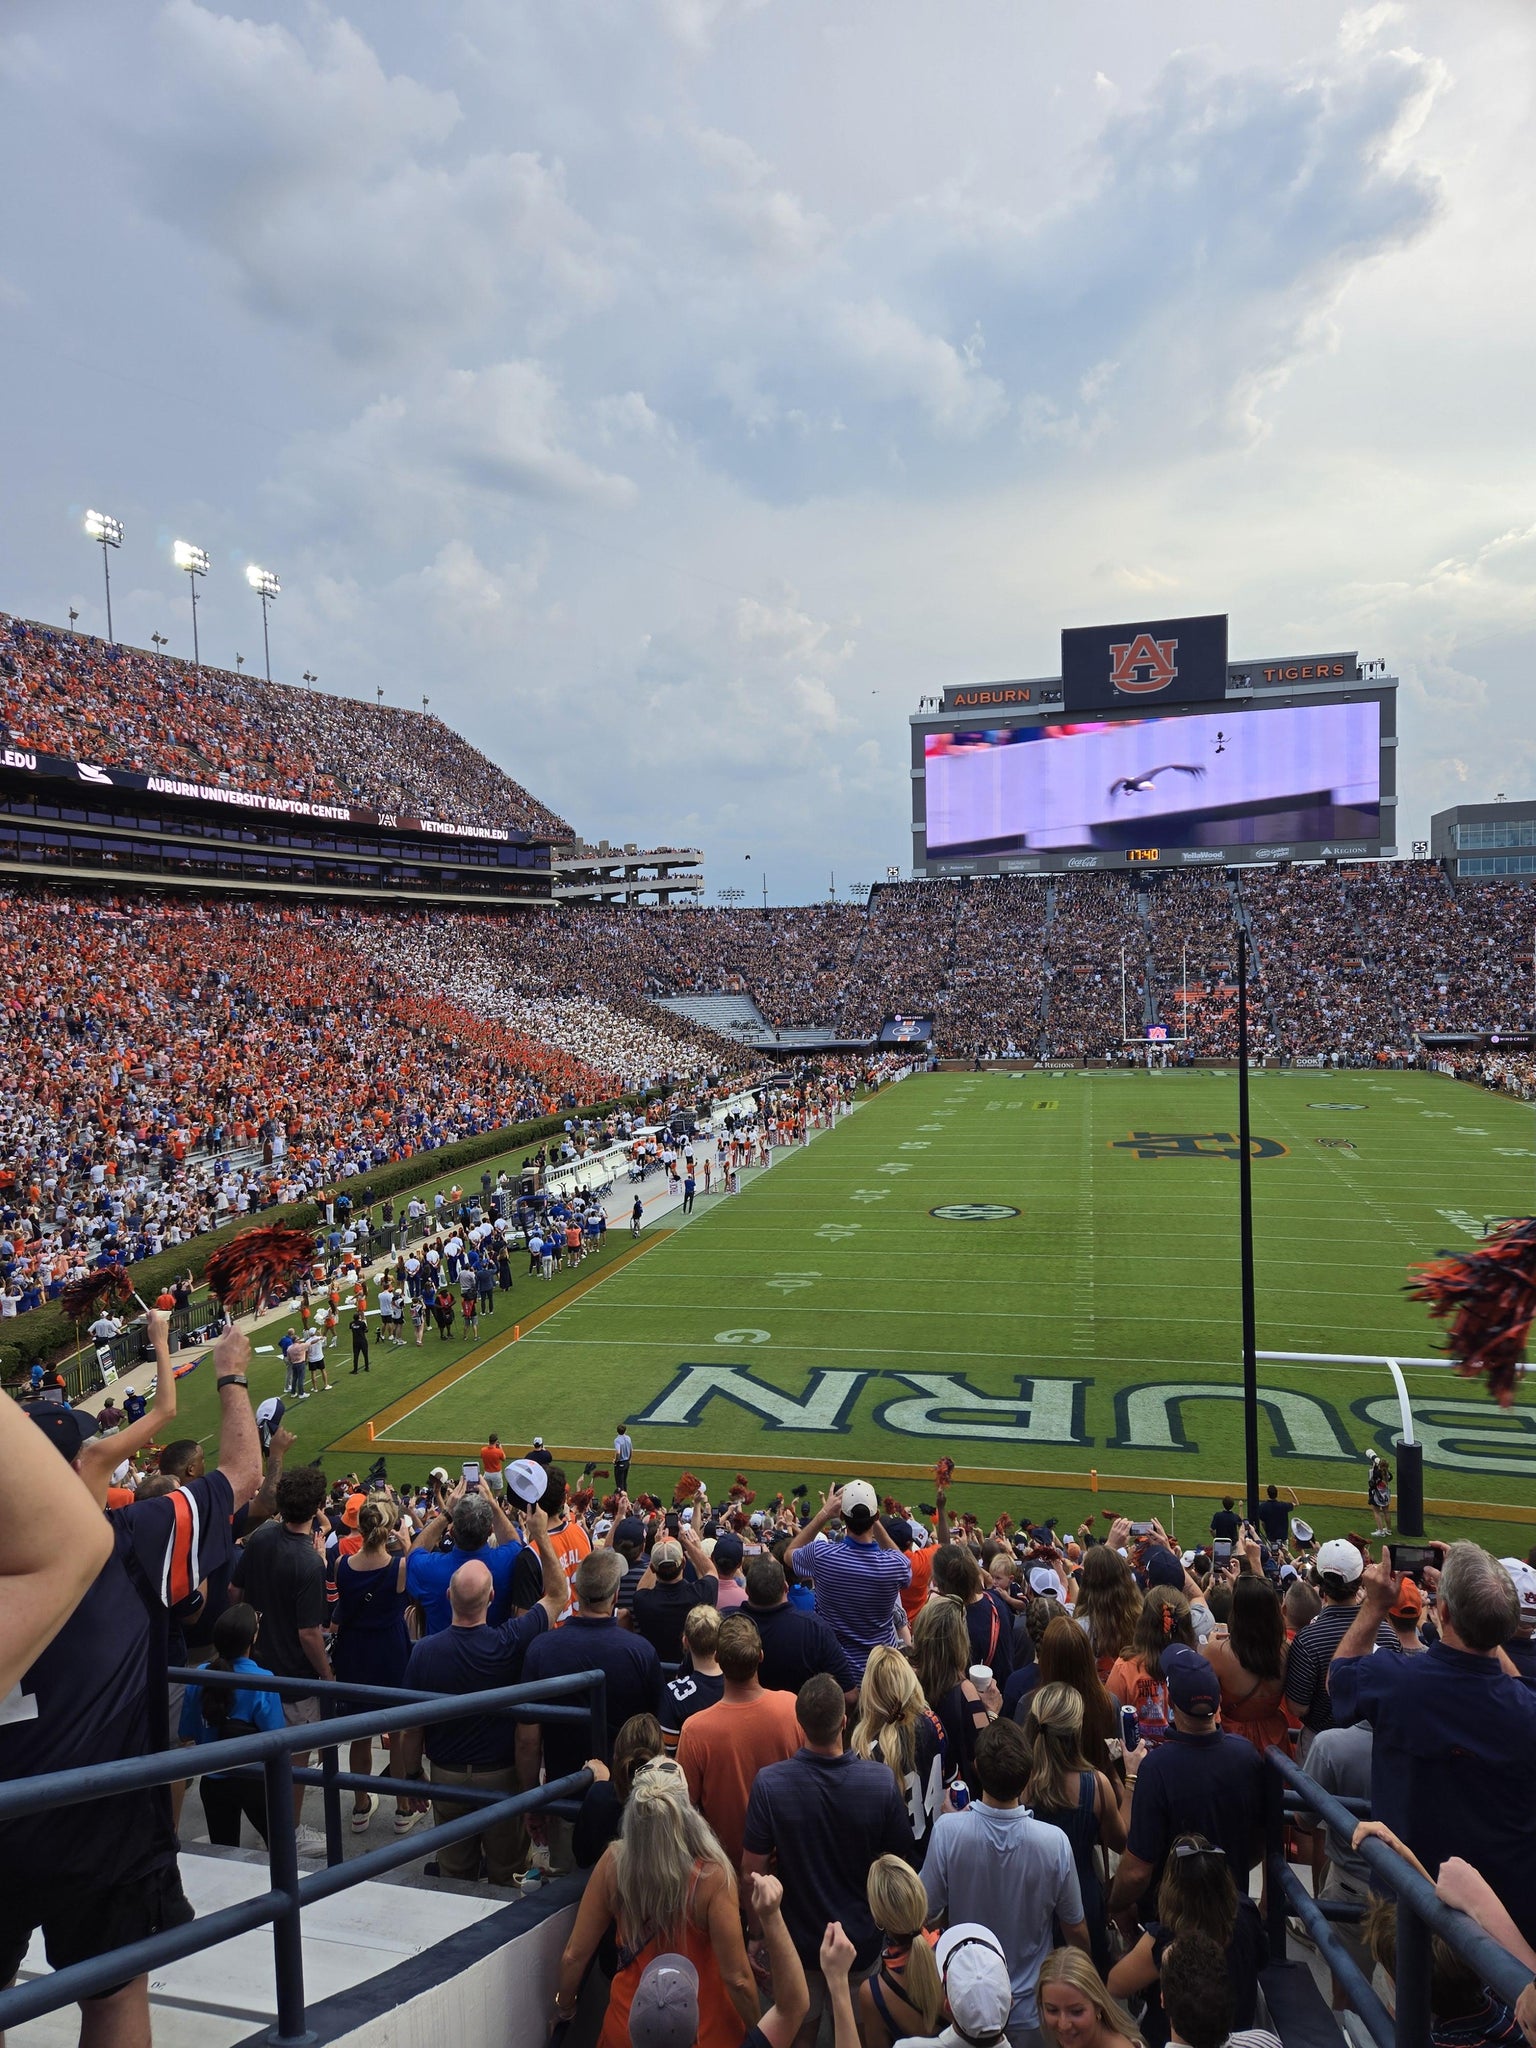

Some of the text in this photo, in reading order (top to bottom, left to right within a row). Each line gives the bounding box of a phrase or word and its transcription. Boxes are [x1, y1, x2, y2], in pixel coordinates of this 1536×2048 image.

[1263, 663, 1345, 682] TIGERS
[953, 688, 1031, 706] AUBURN
[146, 777, 350, 821] AUBURN UNIVERSITY RAPTOR CENTER
[420, 819, 509, 841] VETMED.AUBURN.EDU
[1129, 849, 1159, 861] 17:40
[1333, 847, 1367, 855] REGIONS
[1413, 842, 1427, 851] 25
[887, 867, 899, 876] 25
[765, 1271, 823, 1289] 10
[713, 1328, 772, 1344] G
